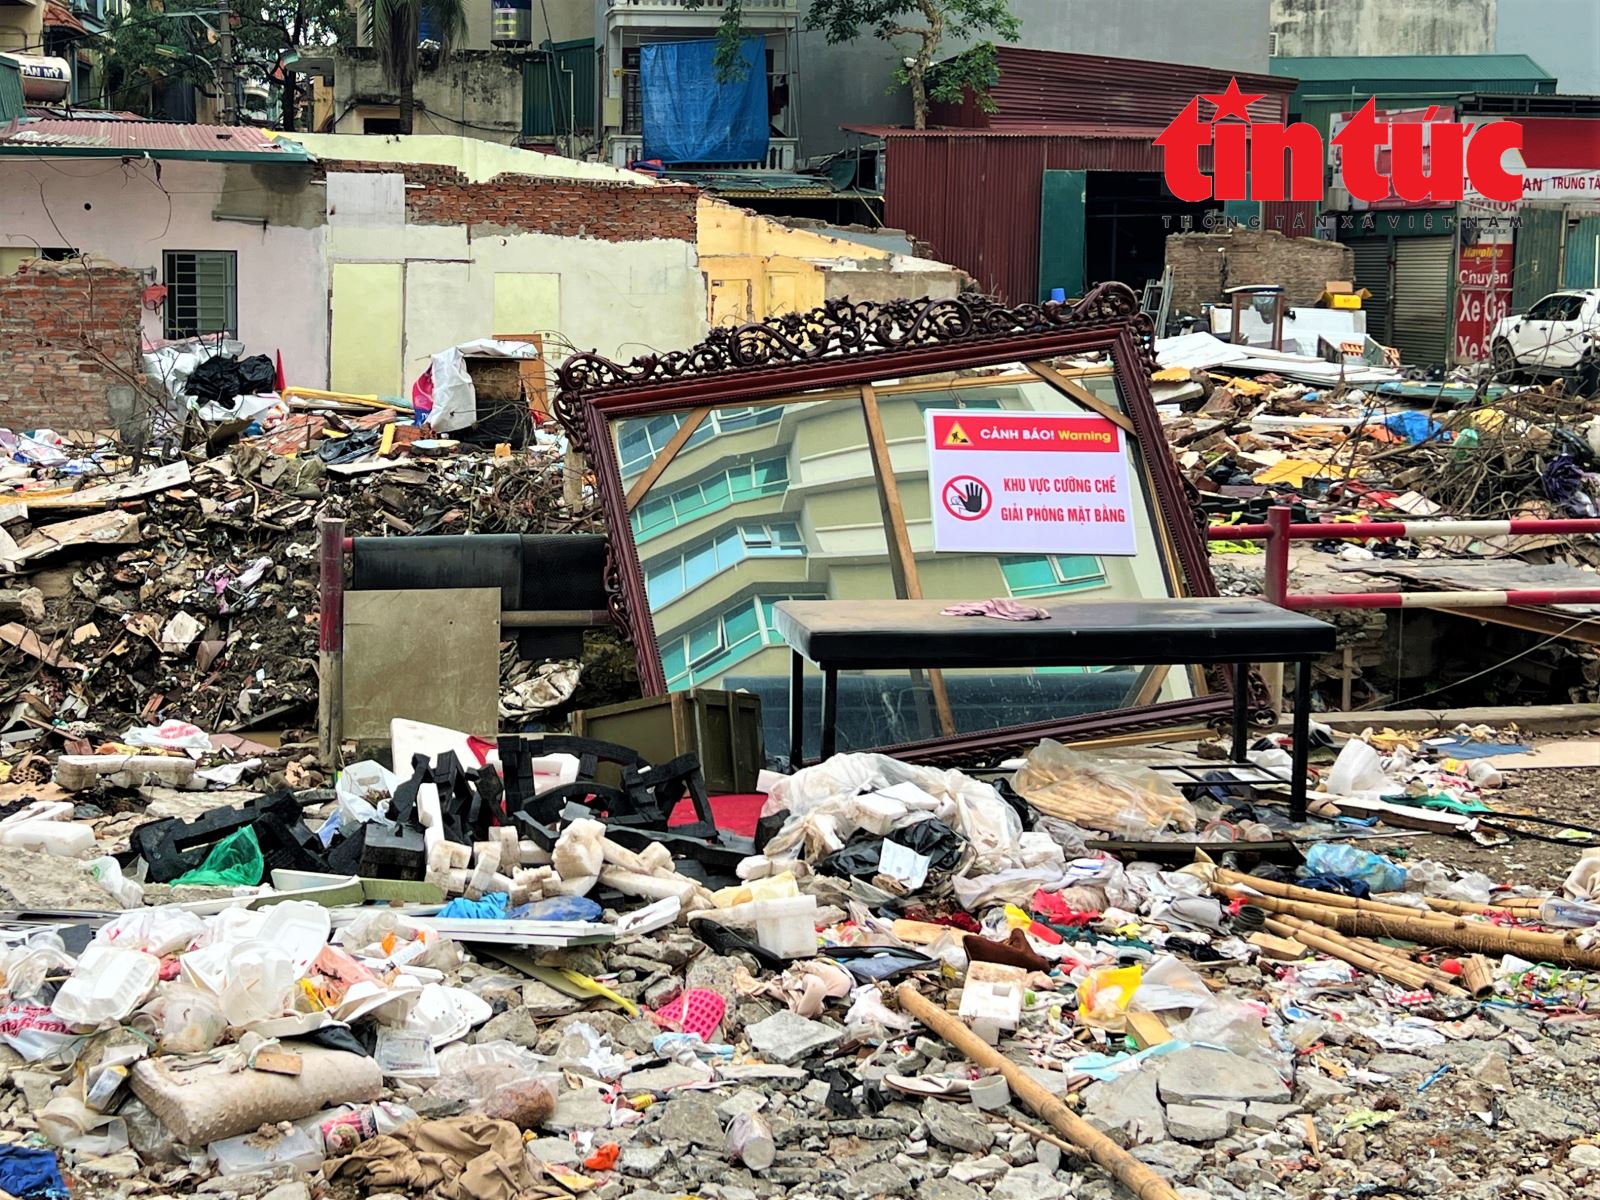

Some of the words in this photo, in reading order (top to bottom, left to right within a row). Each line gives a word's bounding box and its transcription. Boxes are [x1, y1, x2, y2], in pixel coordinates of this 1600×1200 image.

[1551, 176, 1586, 190] TRUNG
[1459, 269, 1508, 288] Chuyên
[1459, 292, 1481, 322] Xe
[1458, 335, 1479, 361] Xe
[979, 426, 1019, 440] CẢNH
[1022, 427, 1055, 440] BÁO!
[1058, 429, 1112, 444] Warning
[1003, 477, 1026, 492] KHU
[1028, 477, 1051, 496] VỰC
[1053, 475, 1092, 493] CƯỠNG
[1095, 474, 1117, 493] CHẾ
[1001, 502, 1023, 521] GIẢI
[1067, 505, 1091, 526] MẶT
[1094, 503, 1125, 523] BẰNG
